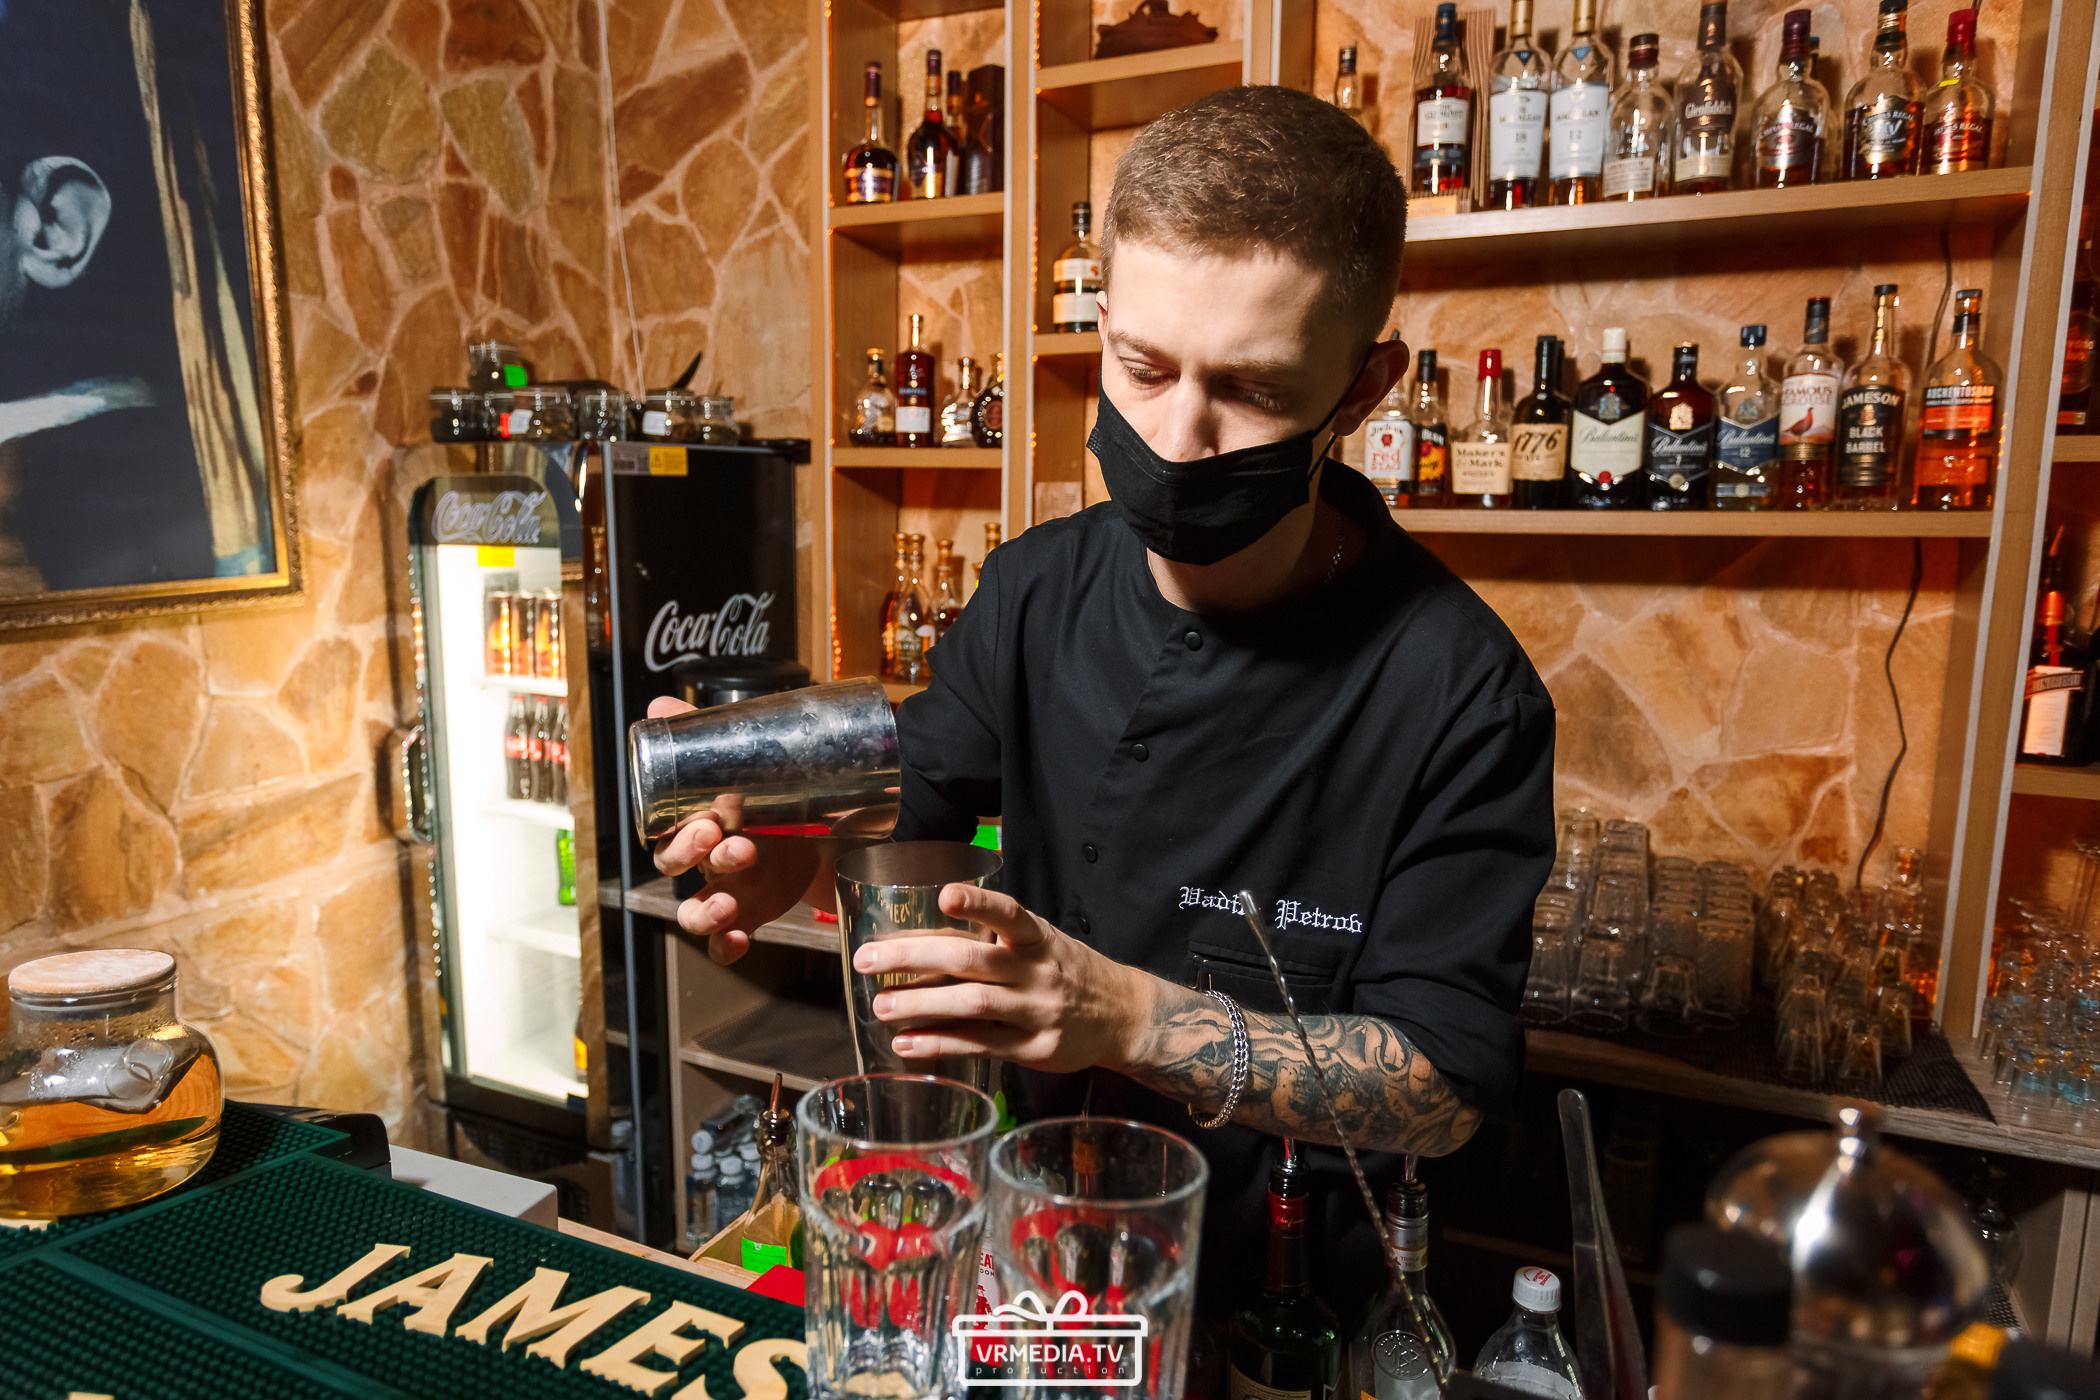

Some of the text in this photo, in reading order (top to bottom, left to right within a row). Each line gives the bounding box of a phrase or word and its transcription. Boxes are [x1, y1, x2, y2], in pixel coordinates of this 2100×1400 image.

[1841, 392, 1901, 410] JAMESON
[1848, 425, 1885, 440] BLACK
[1513, 428, 1563, 454] 1776
[1845, 441, 1886, 454] BARREL
[1372, 448, 1401, 463] red
